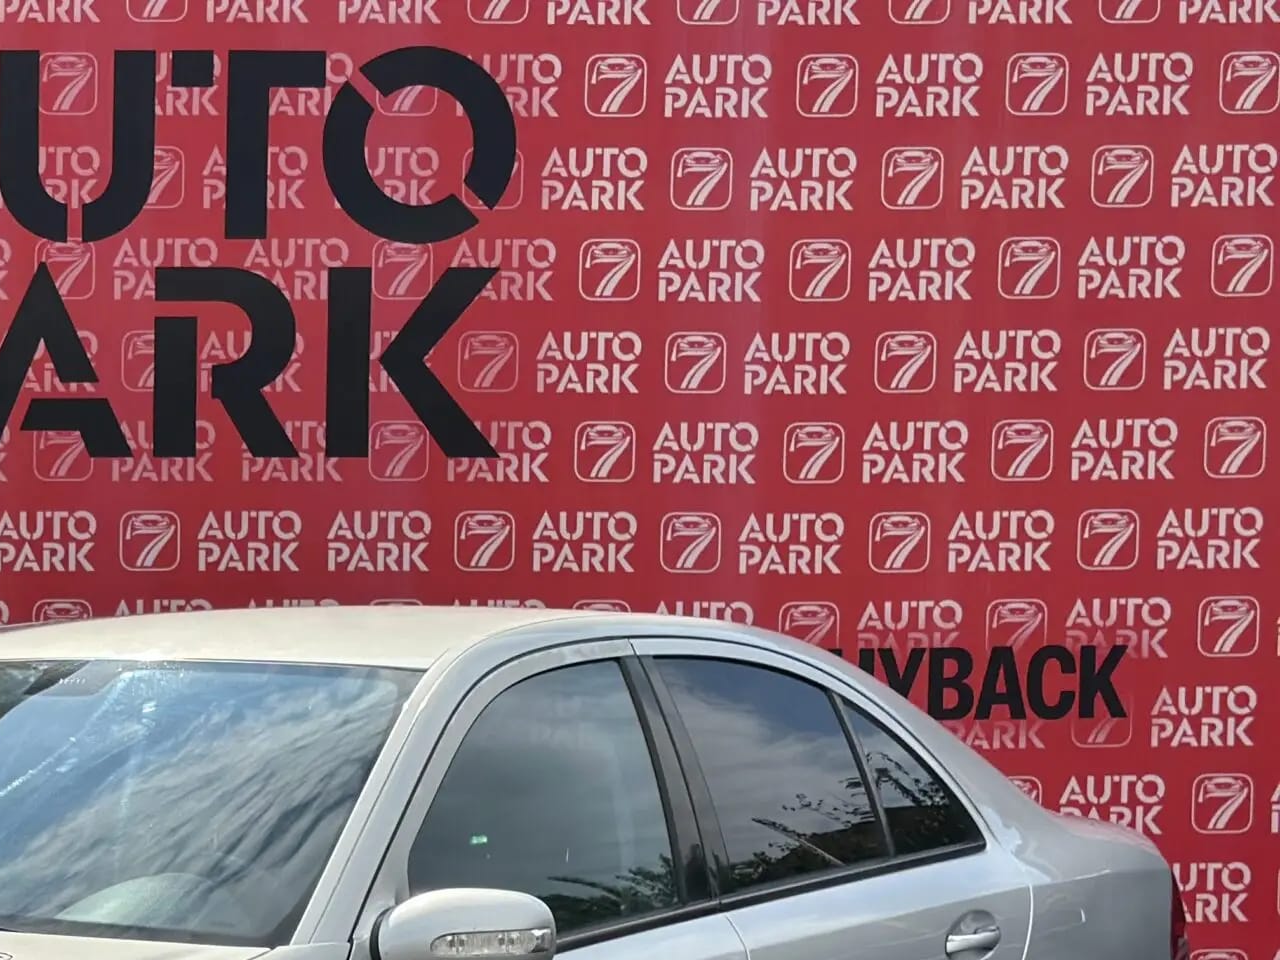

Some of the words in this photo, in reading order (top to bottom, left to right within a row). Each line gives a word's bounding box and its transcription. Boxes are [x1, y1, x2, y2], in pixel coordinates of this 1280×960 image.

[757, 0, 861, 25] PARK
[664, 54, 772, 85] AUTO
[875, 52, 983, 84] AUTO
[1086, 52, 1193, 83] AUTO
[664, 86, 768, 118] PARK
[876, 85, 980, 117] PARK
[1086, 84, 1190, 116] PARK
[541, 147, 648, 178] AUTO
[750, 147, 857, 179] AUTO
[961, 145, 1069, 177] AUTO
[1171, 143, 1278, 175] AUTO
[541, 179, 644, 211] PARK
[750, 180, 854, 211] PARK
[961, 177, 1065, 210] PARK
[1171, 177, 1274, 208] PARK
[113, 238, 218, 267] AUTO
[244, 238, 349, 267] AUTO
[452, 238, 556, 267] AUTO
[657, 239, 765, 270] AUTO
[868, 237, 976, 269] AUTO
[1078, 235, 1185, 267] AUTO
[658, 270, 762, 302] PARK
[868, 269, 972, 302] PARK
[1078, 267, 1182, 299] PARK
[536, 331, 642, 361] AUTO
[744, 332, 850, 363] AUTO
[953, 329, 1061, 360] AUTO
[1163, 326, 1270, 358] AUTO
[537, 363, 639, 394] PARK
[744, 364, 847, 395] PARK
[954, 361, 1058, 393] PARK
[1163, 358, 1267, 390] PARK
[652, 422, 759, 452] AUTO
[862, 420, 968, 451] AUTO
[1071, 417, 1178, 449] AUTO
[112, 453, 213, 481] PARK
[242, 451, 342, 481] PARK
[448, 452, 549, 482] PARK
[653, 453, 756, 484] PARK
[862, 452, 966, 484] PARK
[1071, 449, 1175, 481] PARK
[197, 510, 302, 540] AUTO
[327, 510, 432, 540] AUTO
[532, 510, 637, 541] AUTO
[738, 512, 844, 543] AUTO
[947, 509, 1055, 541] AUTO
[1156, 507, 1264, 538] AUTO
[198, 541, 299, 571] PARK
[328, 541, 429, 572] PARK
[533, 542, 634, 573] PARK
[739, 544, 841, 574] PARK
[948, 541, 1052, 573] PARK
[1157, 538, 1260, 570] PARK
[857, 599, 963, 630] AUTO
[1065, 597, 1171, 627] AUTO
[1151, 685, 1257, 716] AUTO
[1151, 716, 1254, 748] PARK
[1059, 774, 1165, 805] AUTO
